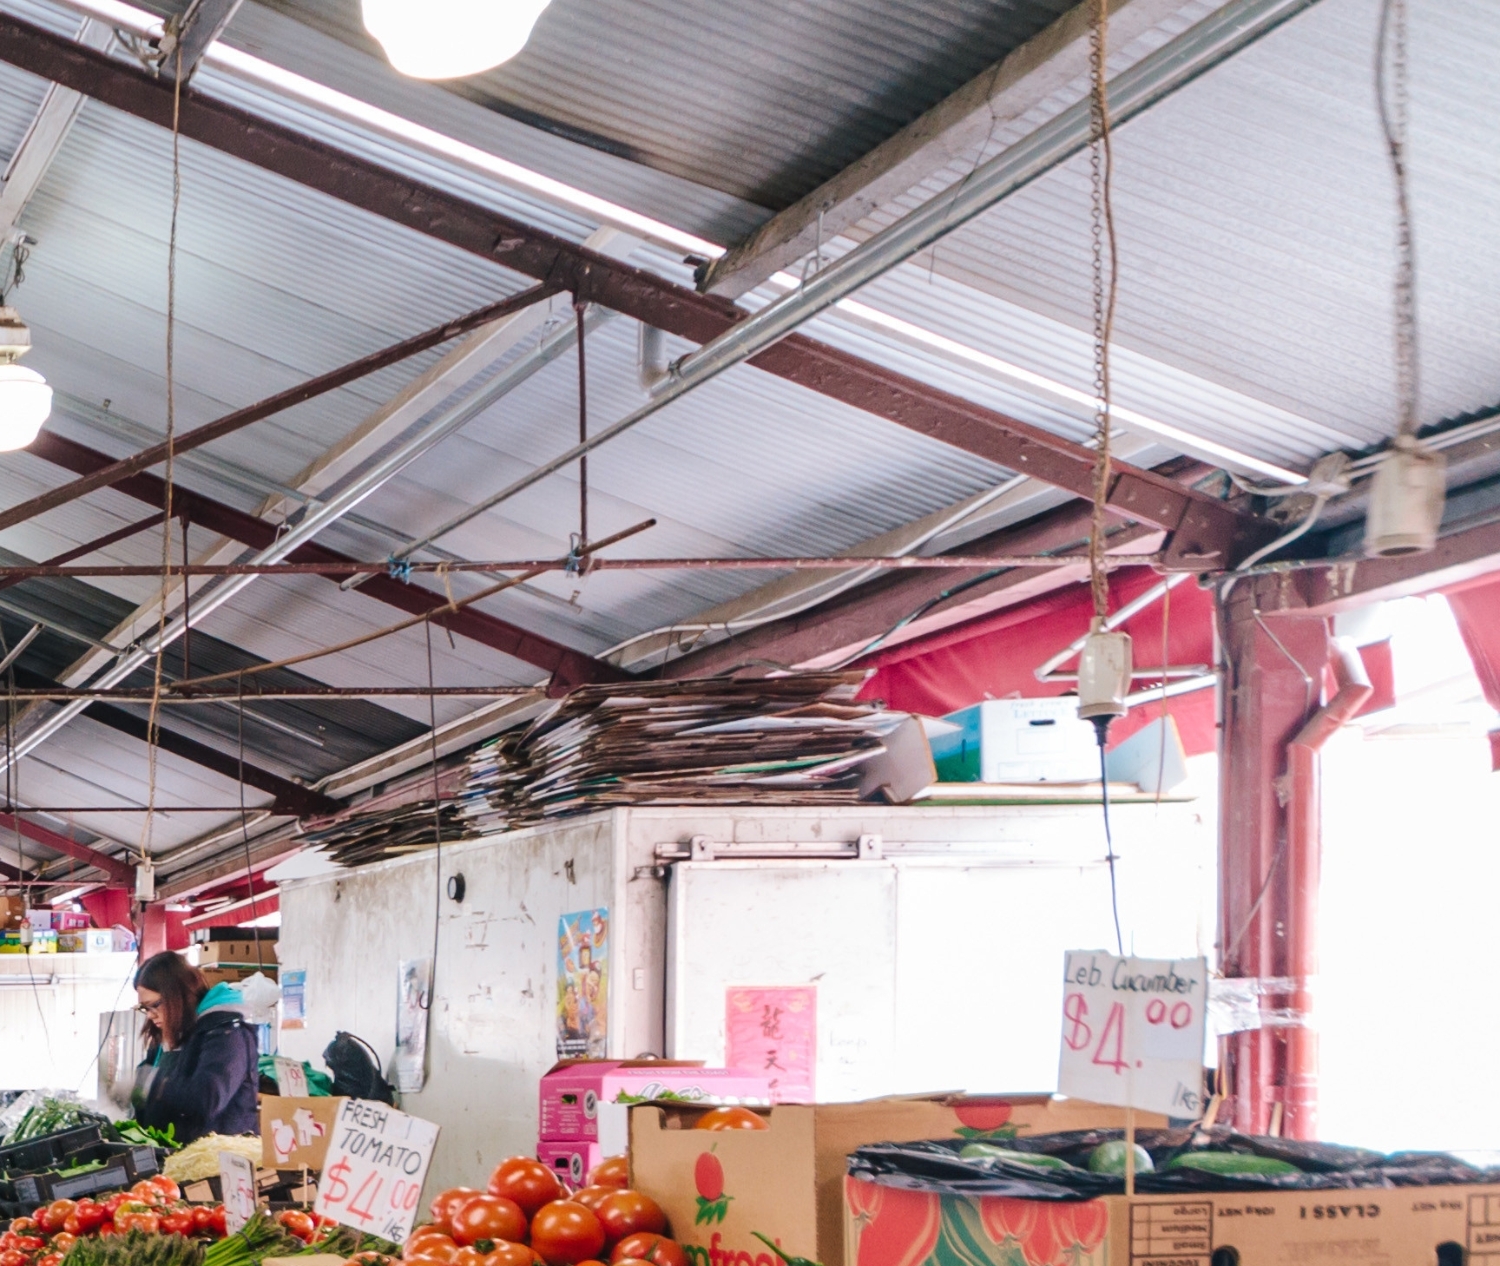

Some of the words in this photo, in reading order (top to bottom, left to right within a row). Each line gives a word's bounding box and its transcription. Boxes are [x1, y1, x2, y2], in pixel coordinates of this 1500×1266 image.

[1111, 958, 1199, 995] Cucumber
[341, 1100, 389, 1135] FRESH
[339, 1127, 422, 1176] TOMATO
[1217, 1208, 1243, 1217] NET
[1313, 1203, 1381, 1219] CLASS
